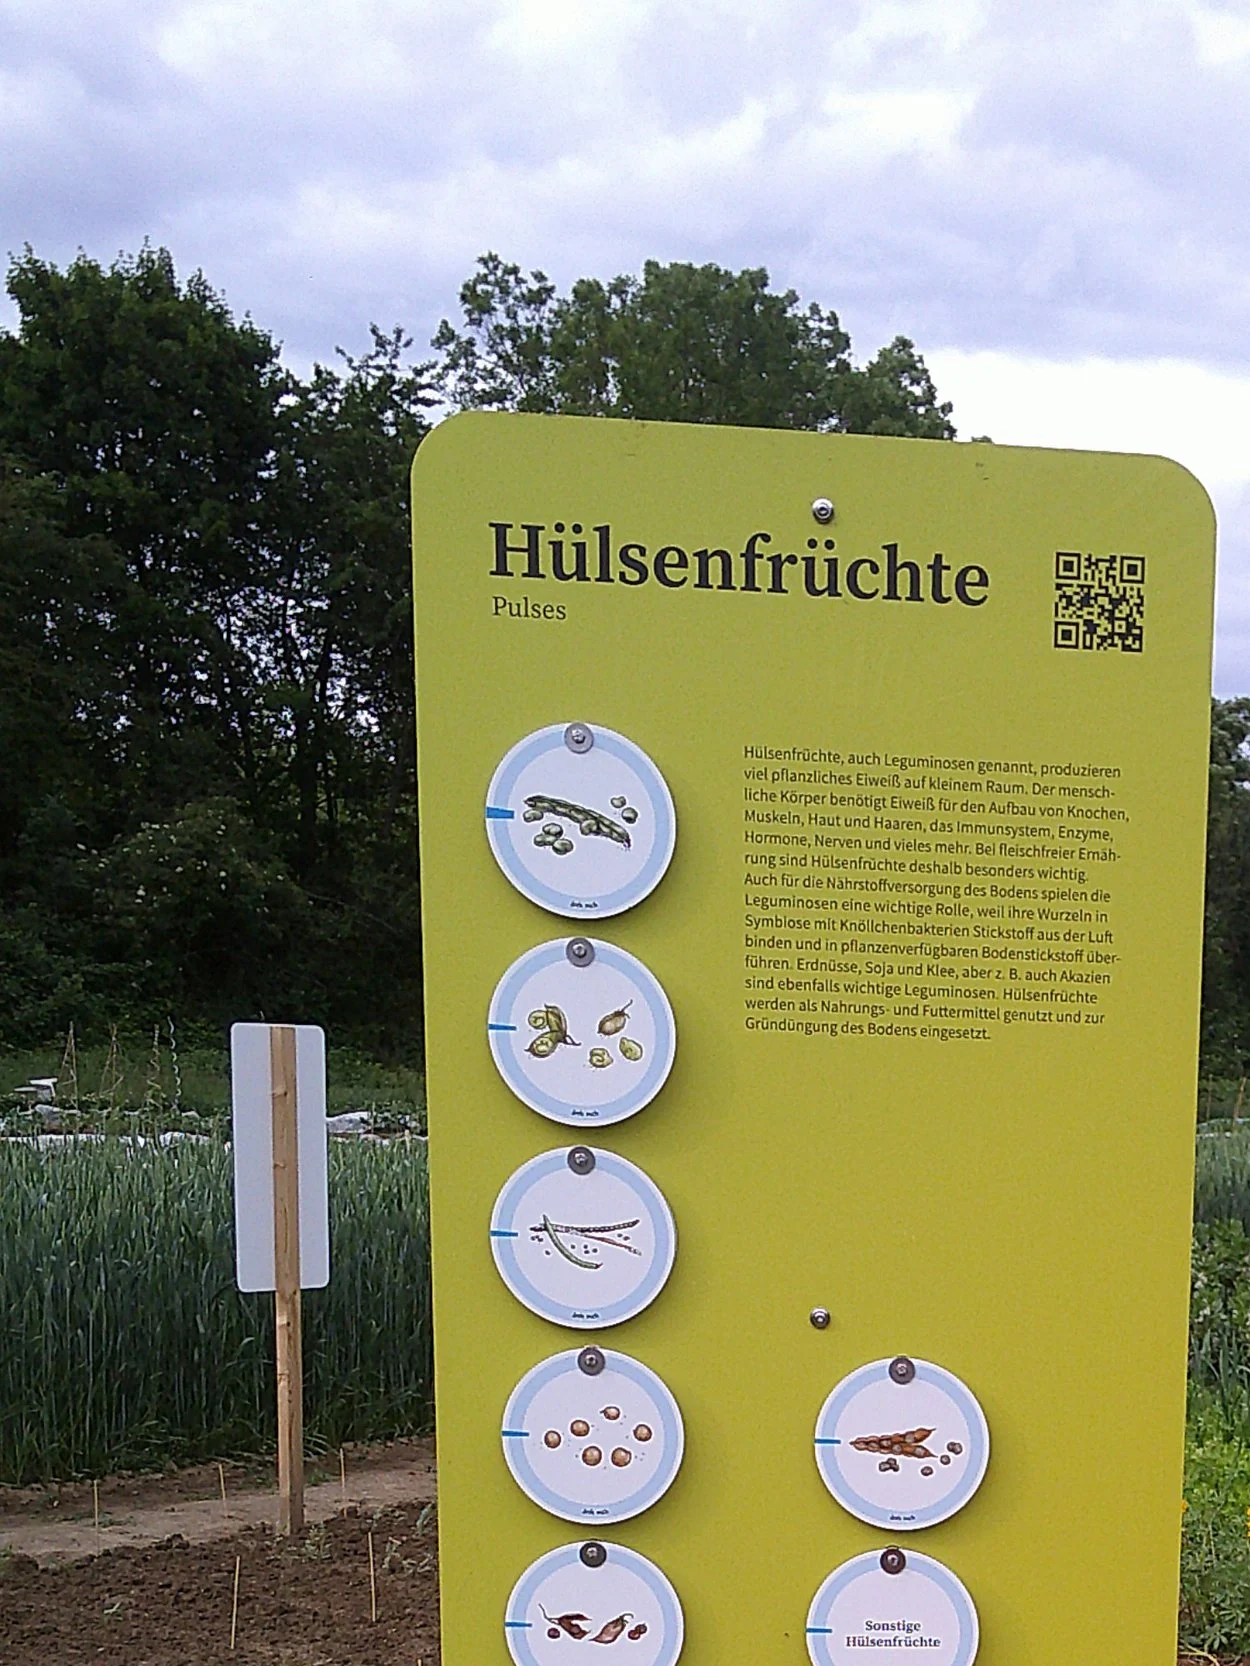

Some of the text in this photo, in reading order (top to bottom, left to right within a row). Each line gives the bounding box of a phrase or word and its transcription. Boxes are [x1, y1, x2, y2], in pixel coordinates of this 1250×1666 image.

[488, 520, 989, 607] Hülsenfrüchte
[491, 595, 567, 621] Pulses
[744, 745, 1121, 779] Hülsenfrüchte, auch Leguminosen genannt, produzieren
[744, 766, 1116, 799] viel pflanzliches Eiweiß auf kleinem Raum. Der mensch-
[744, 787, 1130, 823] liche Körper benötigt Eiweiß für den Aufbau von Knochen,
[744, 809, 1114, 844] Muskeln, Haut und Haaren, das Immunsystem, Enzyme,
[745, 830, 812, 849] Hormone,
[814, 834, 862, 849] Nerven
[865, 837, 891, 851] und
[894, 838, 932, 853] vieles
[935, 840, 972, 855] mehr.
[975, 842, 996, 857] Bei
[999, 842, 1076, 860] fleischfreier
[745, 853, 1089, 885] rung sind Hülsenfrüchte deshalb besonders wichtig.
[744, 872, 1111, 903] Auch für die Nährstoffversorgung des Bodens spielen die
[745, 893, 1108, 924] Leguminosen eine wichtige Rolle, weil ihre Wurzeln in
[745, 913, 1114, 945] Symbiose mit Knöllchenbakterien Stickstoff aus der Luft
[745, 933, 1122, 965] binden und in pflanzenverfügbaren Bodenstickstoff über-
[797, 957, 862, 976] Erdnüsse,
[865, 961, 894, 978] Soja
[897, 962, 923, 976] und
[927, 963, 959, 980] Klee,
[962, 965, 993, 980] aber
[1009, 967, 1022, 981] B.
[1025, 968, 1057, 982] auch
[1059, 969, 1111, 985] Akazien
[745, 975, 774, 990] sind
[777, 977, 841, 993] ebenfalls
[843, 980, 902, 999] wichtige
[1003, 987, 1098, 1005] Hülsenfrüchte
[745, 997, 796, 1011] werden
[799, 998, 818, 1013] als
[893, 1003, 919, 1017] und
[922, 1004, 1001, 1021] Futtermittel
[1003, 1010, 1053, 1024] genutzt
[1056, 1010, 1081, 1024] und
[1084, 1014, 1105, 1025] zur
[745, 1016, 992, 1042] Gründüngung des Bodens eingesetzt.
[846, 1635, 941, 1648] Hülsenfrüchte
[865, 1619, 922, 1634] Sonstige
